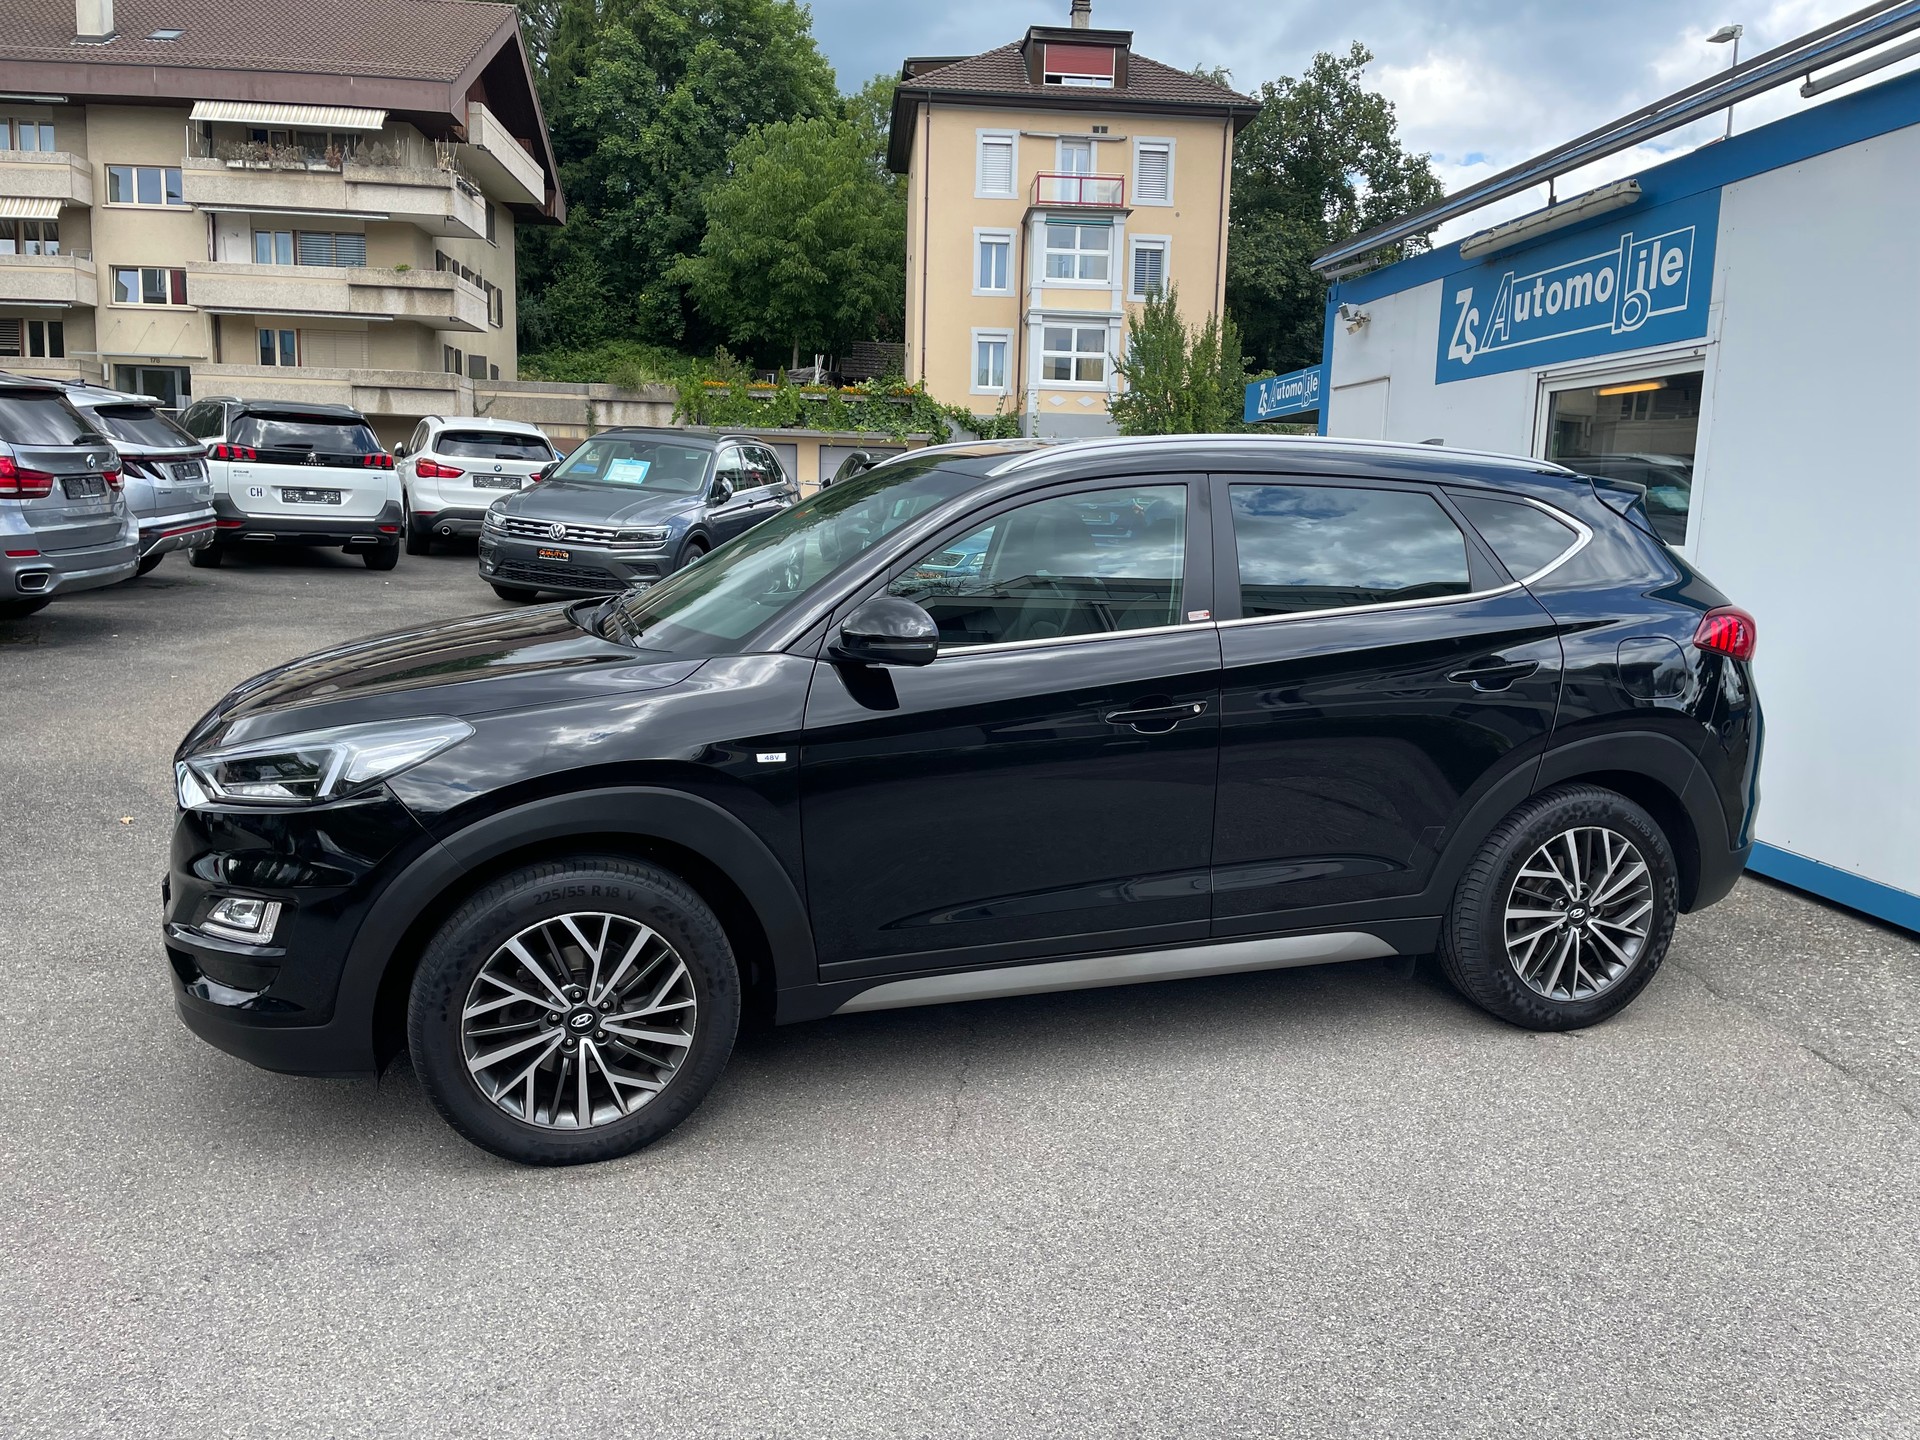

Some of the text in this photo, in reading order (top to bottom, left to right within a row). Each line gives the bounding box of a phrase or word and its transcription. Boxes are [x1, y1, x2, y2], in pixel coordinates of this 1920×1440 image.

[1478, 232, 1685, 352] Automobile
[1266, 369, 1319, 411] Automobile
[250, 487, 263, 497] CH
[533, 885, 585, 905] 225/55
[591, 885, 601, 897] R
[605, 885, 620, 898] 18
